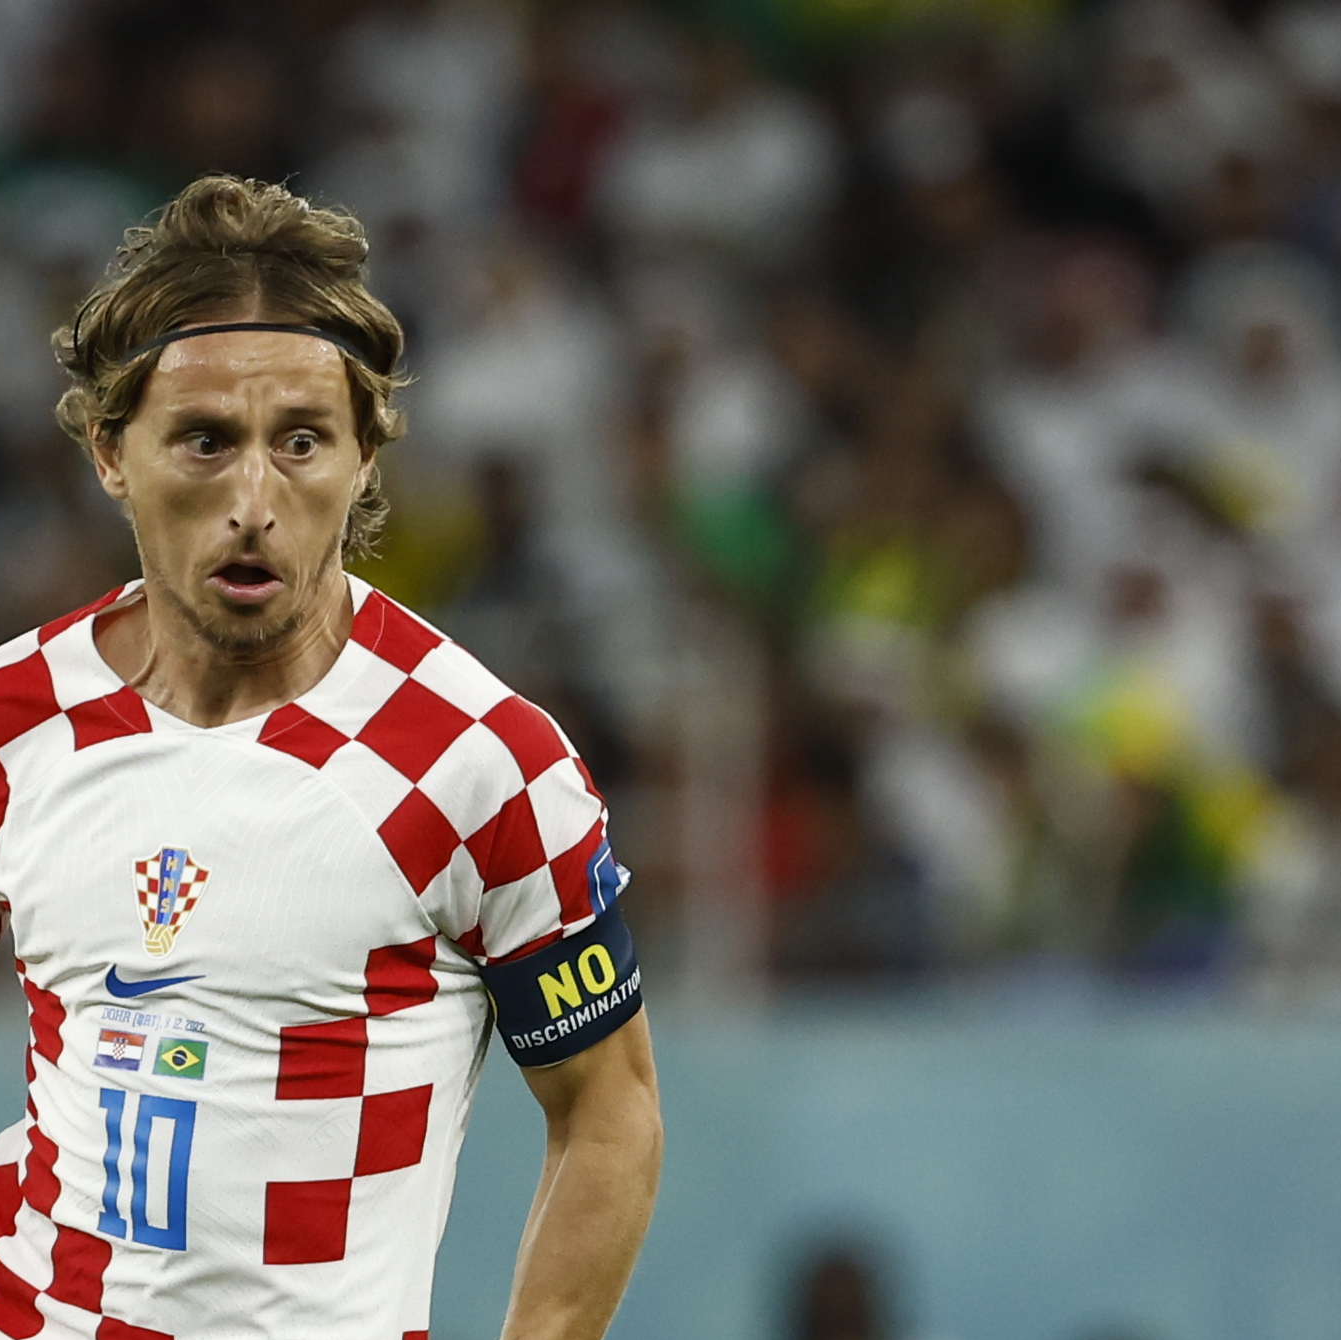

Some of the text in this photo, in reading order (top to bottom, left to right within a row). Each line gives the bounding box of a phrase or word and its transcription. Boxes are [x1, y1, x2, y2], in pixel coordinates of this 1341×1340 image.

[159, 855, 180, 914] HNS
[536, 943, 617, 1019] NO
[97, 1087, 197, 1252] 10
